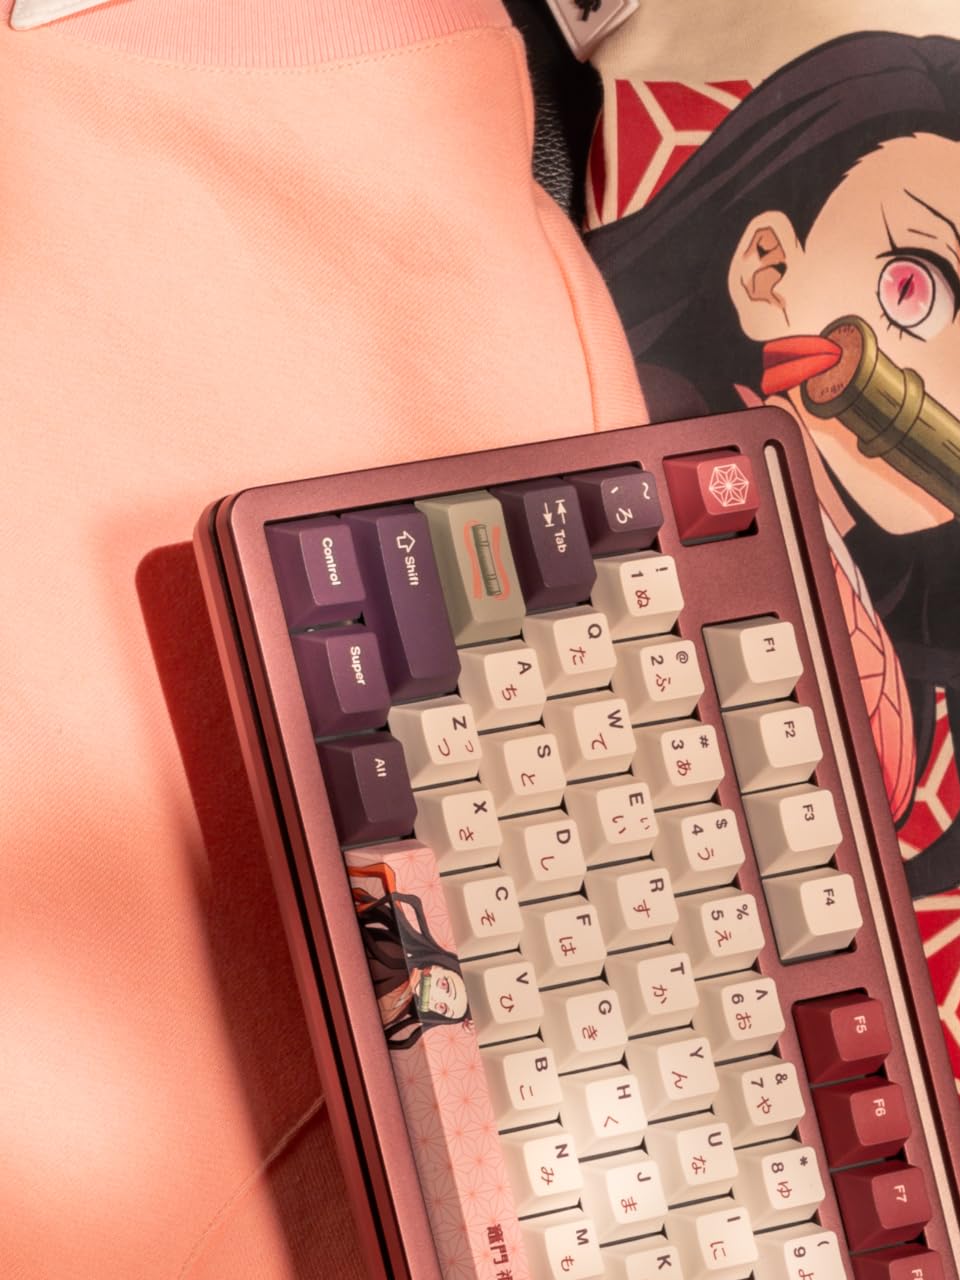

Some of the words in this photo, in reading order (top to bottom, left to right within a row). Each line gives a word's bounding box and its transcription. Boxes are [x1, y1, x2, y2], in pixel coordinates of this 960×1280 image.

[615, 507, 633, 524] ろ
[553, 529, 567, 553] Tab
[321, 536, 342, 586] Control
[404, 554, 420, 586] Shift
[630, 570, 645, 579] 1
[634, 588, 652, 609] ぬ
[586, 623, 603, 640] Q
[762, 636, 777, 654] F1
[568, 645, 587, 666] た
[650, 654, 665, 667] 2
[349, 645, 367, 686] Super
[516, 660, 533, 676] A
[655, 673, 672, 693] ふ
[501, 683, 518, 702] ち
[451, 715, 468, 732] Z
[606, 709, 625, 730] W
[783, 720, 797, 739] F2
[437, 737, 451, 758] つ
[590, 731, 608, 751] て
[671, 739, 685, 751] 3
[536, 744, 552, 760] S
[373, 757, 388, 778] Alt
[675, 759, 692, 777] あ
[520, 772, 537, 787] と
[472, 800, 489, 815] X
[628, 791, 645, 808] E
[801, 803, 816, 822] F3
[611, 814, 627, 835] い
[691, 823, 705, 837] 4
[458, 825, 475, 842] さ
[555, 828, 572, 845] D
[696, 847, 715, 862] う
[539, 855, 556, 872] し
[494, 886, 510, 902] C
[648, 877, 665, 894] R
[822, 887, 836, 907] F4
[632, 898, 652, 919] す
[710, 909, 725, 922] 5
[480, 908, 496, 928] そ
[575, 913, 593, 927] F
[558, 935, 577, 957] は
[714, 929, 733, 948] え
[669, 961, 686, 976] T
[515, 971, 530, 985] V
[651, 983, 669, 1005] か
[731, 992, 745, 1005] 6
[499, 993, 516, 1014] ひ
[597, 999, 613, 1016] G
[735, 1011, 753, 1031] お
[853, 1015, 868, 1034] F5
[581, 1024, 599, 1041] き
[688, 1046, 705, 1060] Y
[534, 1056, 549, 1073] B
[671, 1070, 689, 1090] ん
[750, 1076, 765, 1089] 7
[519, 1084, 534, 1101] こ
[616, 1084, 633, 1101] H
[755, 1095, 773, 1115] や
[872, 1098, 887, 1118] F6
[603, 1115, 620, 1128] く
[707, 1131, 724, 1148] U
[554, 1143, 570, 1160] N
[690, 1154, 708, 1176] な
[771, 1161, 785, 1174] 8
[539, 1165, 555, 1186] み
[636, 1171, 652, 1183] J
[776, 1180, 793, 1199] ゆ
[893, 1184, 908, 1203] F7
[620, 1195, 639, 1214] ま
[575, 1227, 590, 1247] M
[709, 1240, 727, 1261] に
[793, 1245, 807, 1259] 9
[560, 1255, 576, 1273] も
[656, 1254, 673, 1271] K
